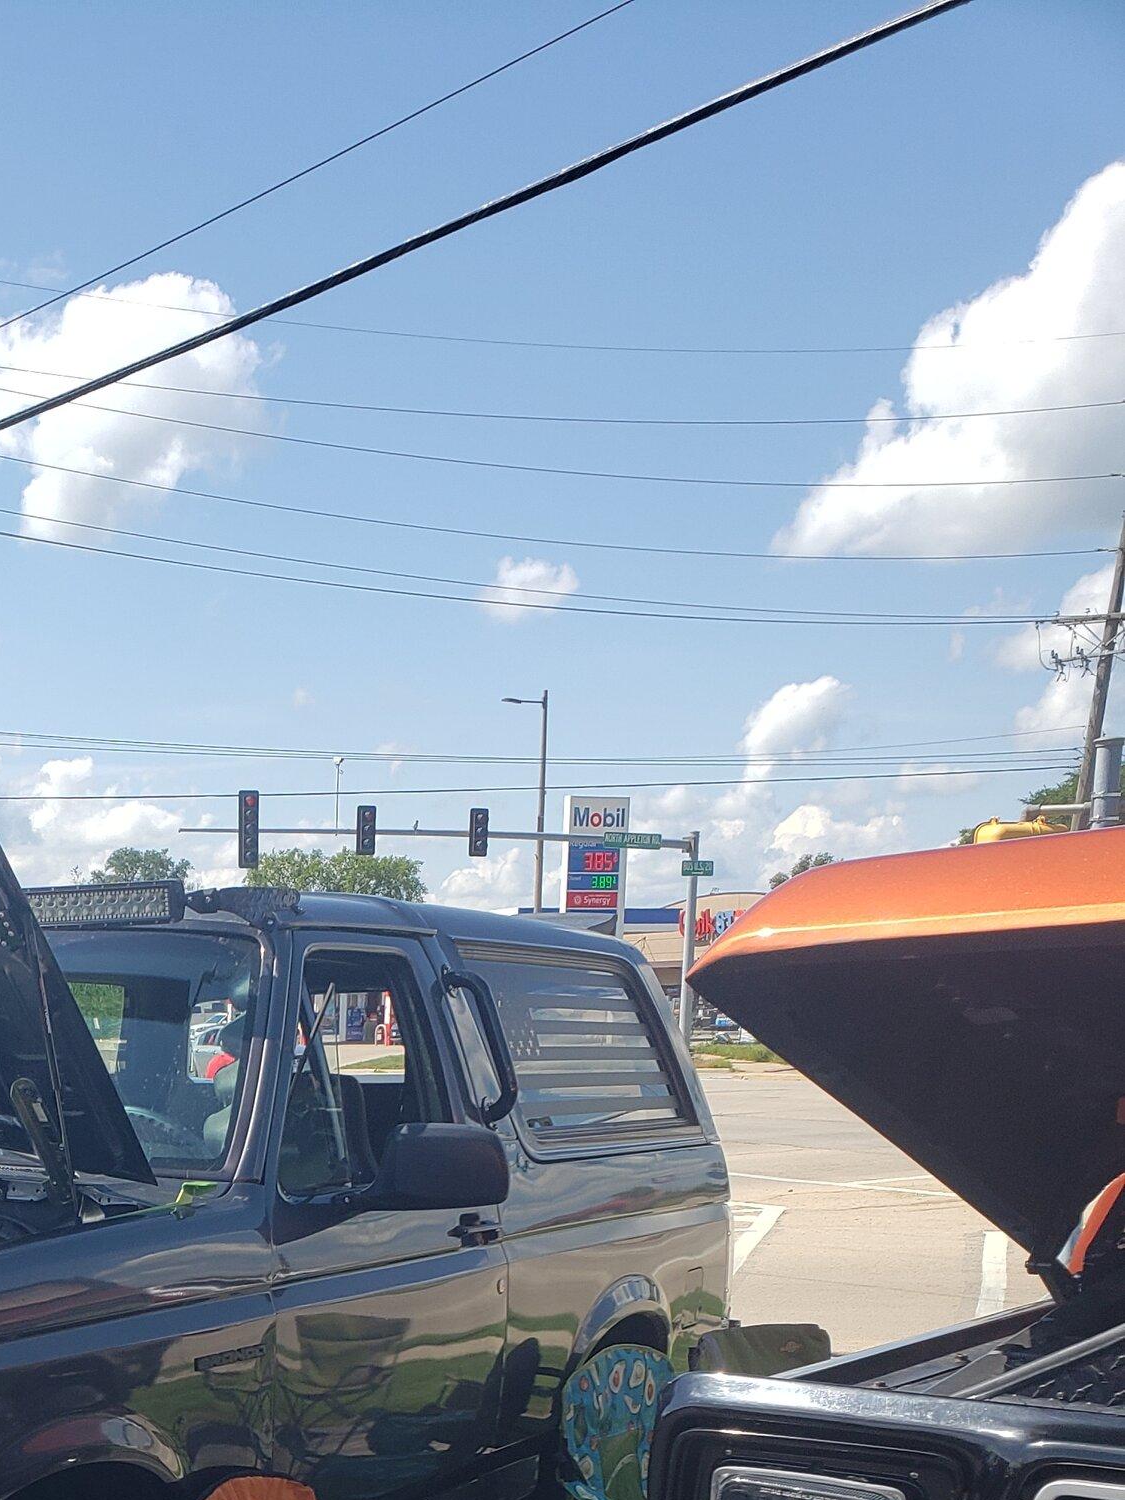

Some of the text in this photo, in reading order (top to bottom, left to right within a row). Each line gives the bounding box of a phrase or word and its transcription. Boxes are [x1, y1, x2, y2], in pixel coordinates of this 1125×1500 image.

[573, 806, 626, 828] Mobil
[605, 833, 623, 843] NORTH
[623, 834, 651, 844] APPLETON
[583, 895, 611, 906] Synergy
